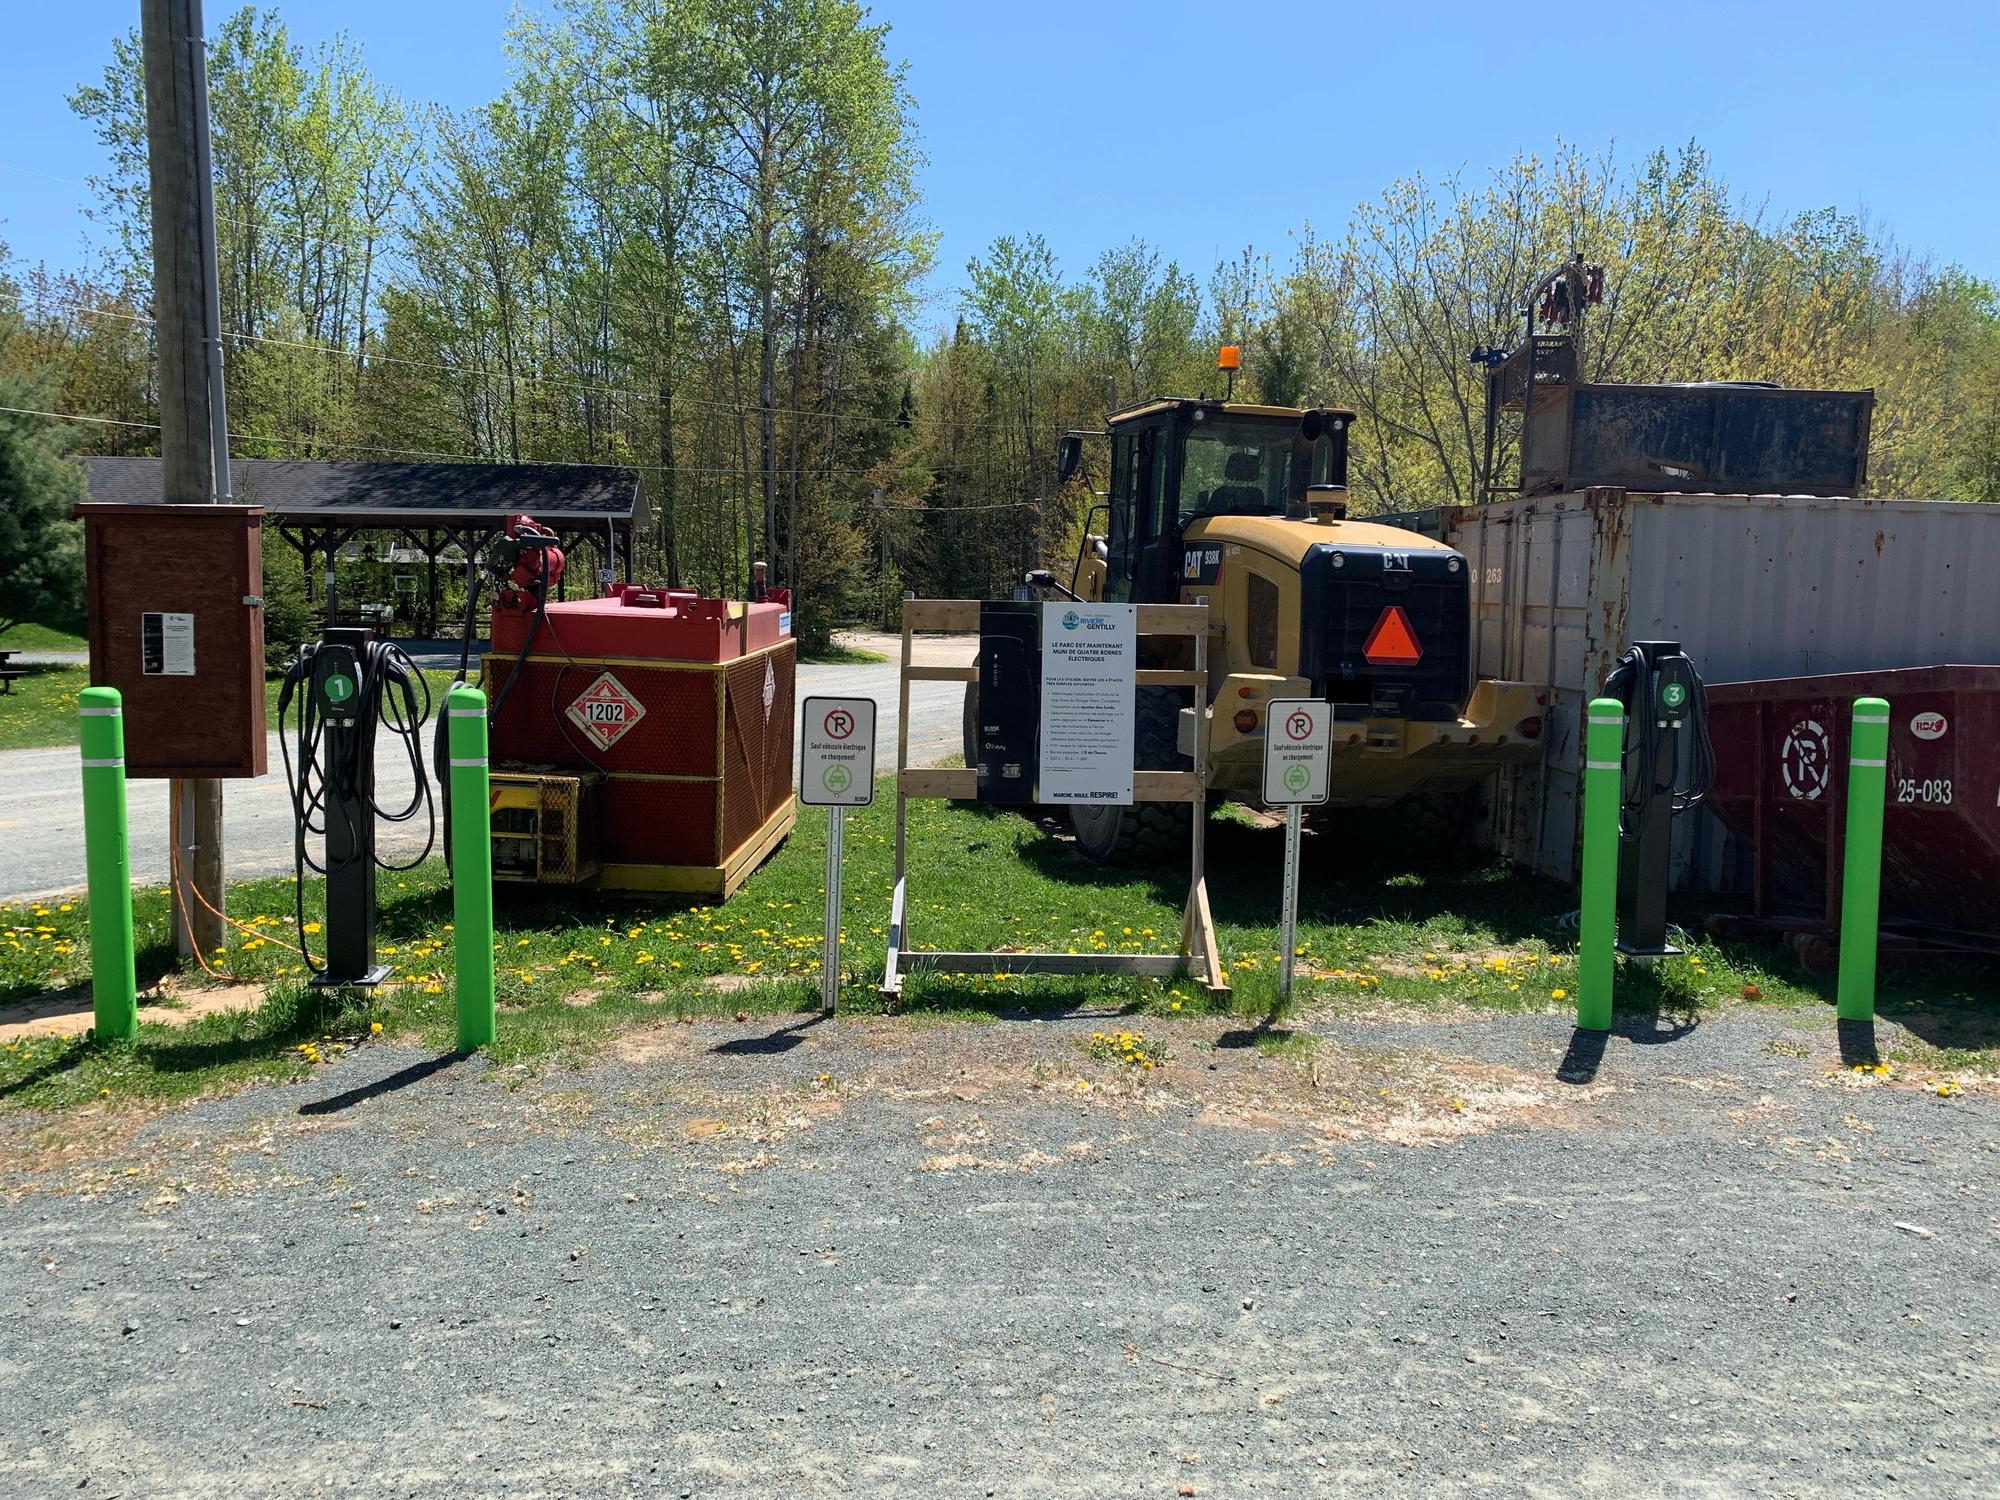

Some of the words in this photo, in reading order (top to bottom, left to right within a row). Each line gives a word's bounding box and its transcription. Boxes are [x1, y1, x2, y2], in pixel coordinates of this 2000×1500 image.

[1184, 551, 1203, 578] CAT
[1204, 550, 1220, 565] 938K
[1486, 568, 1502, 583] 263
[334, 679, 344, 697] 1
[1668, 687, 1680, 702] 3
[587, 703, 623, 721] 1202
[601, 728, 608, 737] 3
[810, 742, 821, 750] Sauf
[827, 754, 856, 762] chargement
[1288, 754, 1313, 762] chargement
[1898, 779, 1952, 804] 25-083
